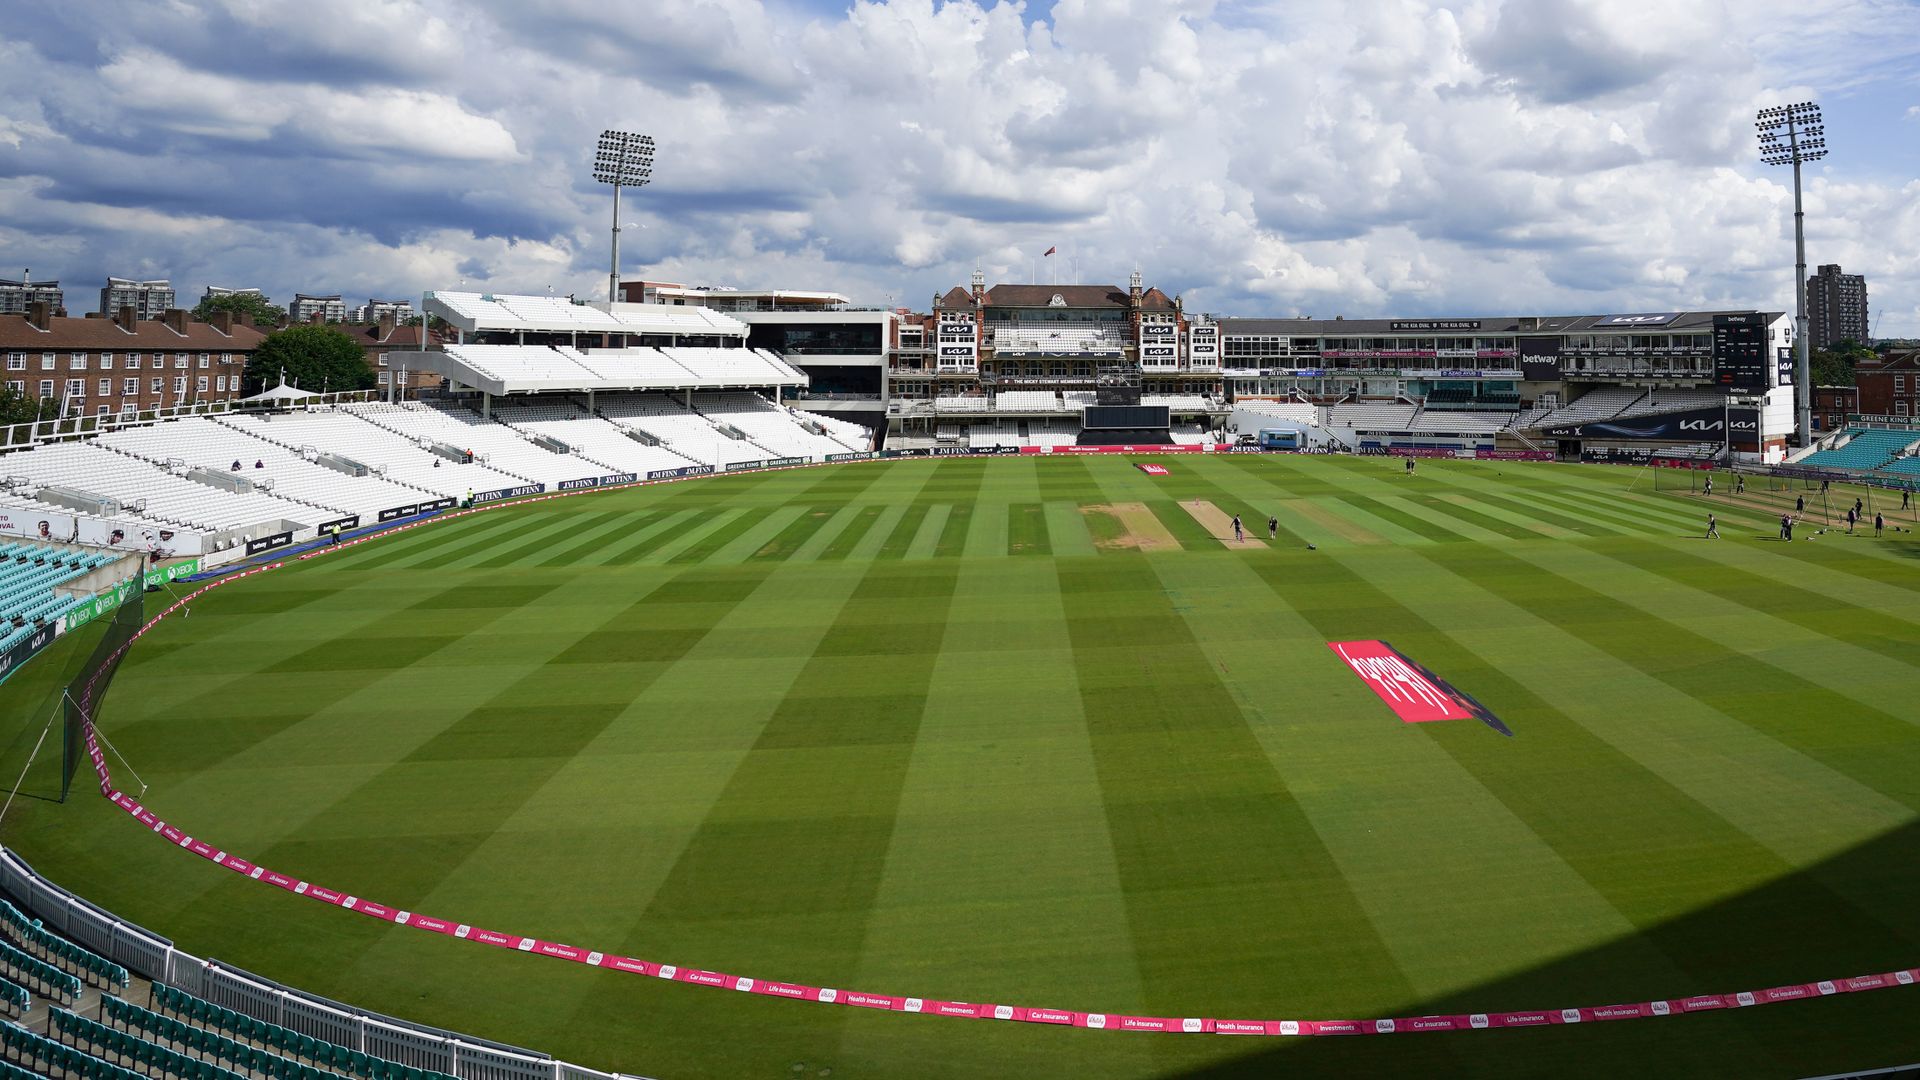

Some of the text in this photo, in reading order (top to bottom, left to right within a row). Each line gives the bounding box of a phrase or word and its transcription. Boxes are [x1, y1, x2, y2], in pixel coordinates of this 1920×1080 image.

[1781, 349, 1789, 358] THE
[1522, 354, 1558, 366] betway
[651, 470, 678, 479] JM FINN
[695, 466, 711, 474] FINN
[605, 474, 633, 484] JM FINN
[563, 479, 594, 489] JM FINN
[511, 485, 540, 496] JM FINN
[474, 491, 502, 502] JM FINN
[252, 540, 268, 551] betway
[272, 536, 287, 546] betway
[175, 563, 194, 576] XBOX
[147, 573, 162, 586] XBOX
[77, 607, 91, 624] XBOX
[543, 945, 557, 953] Health
[617, 961, 644, 970] Investments
[848, 995, 865, 1003] Health
[1688, 1000, 1719, 1008] Investments
[941, 1006, 974, 1015] Investments
[1594, 1009, 1613, 1017] Health
[1042, 1013, 1069, 1021] insurance
[1519, 1014, 1544, 1022] insurance
[1125, 1019, 1163, 1028] Life insurance
